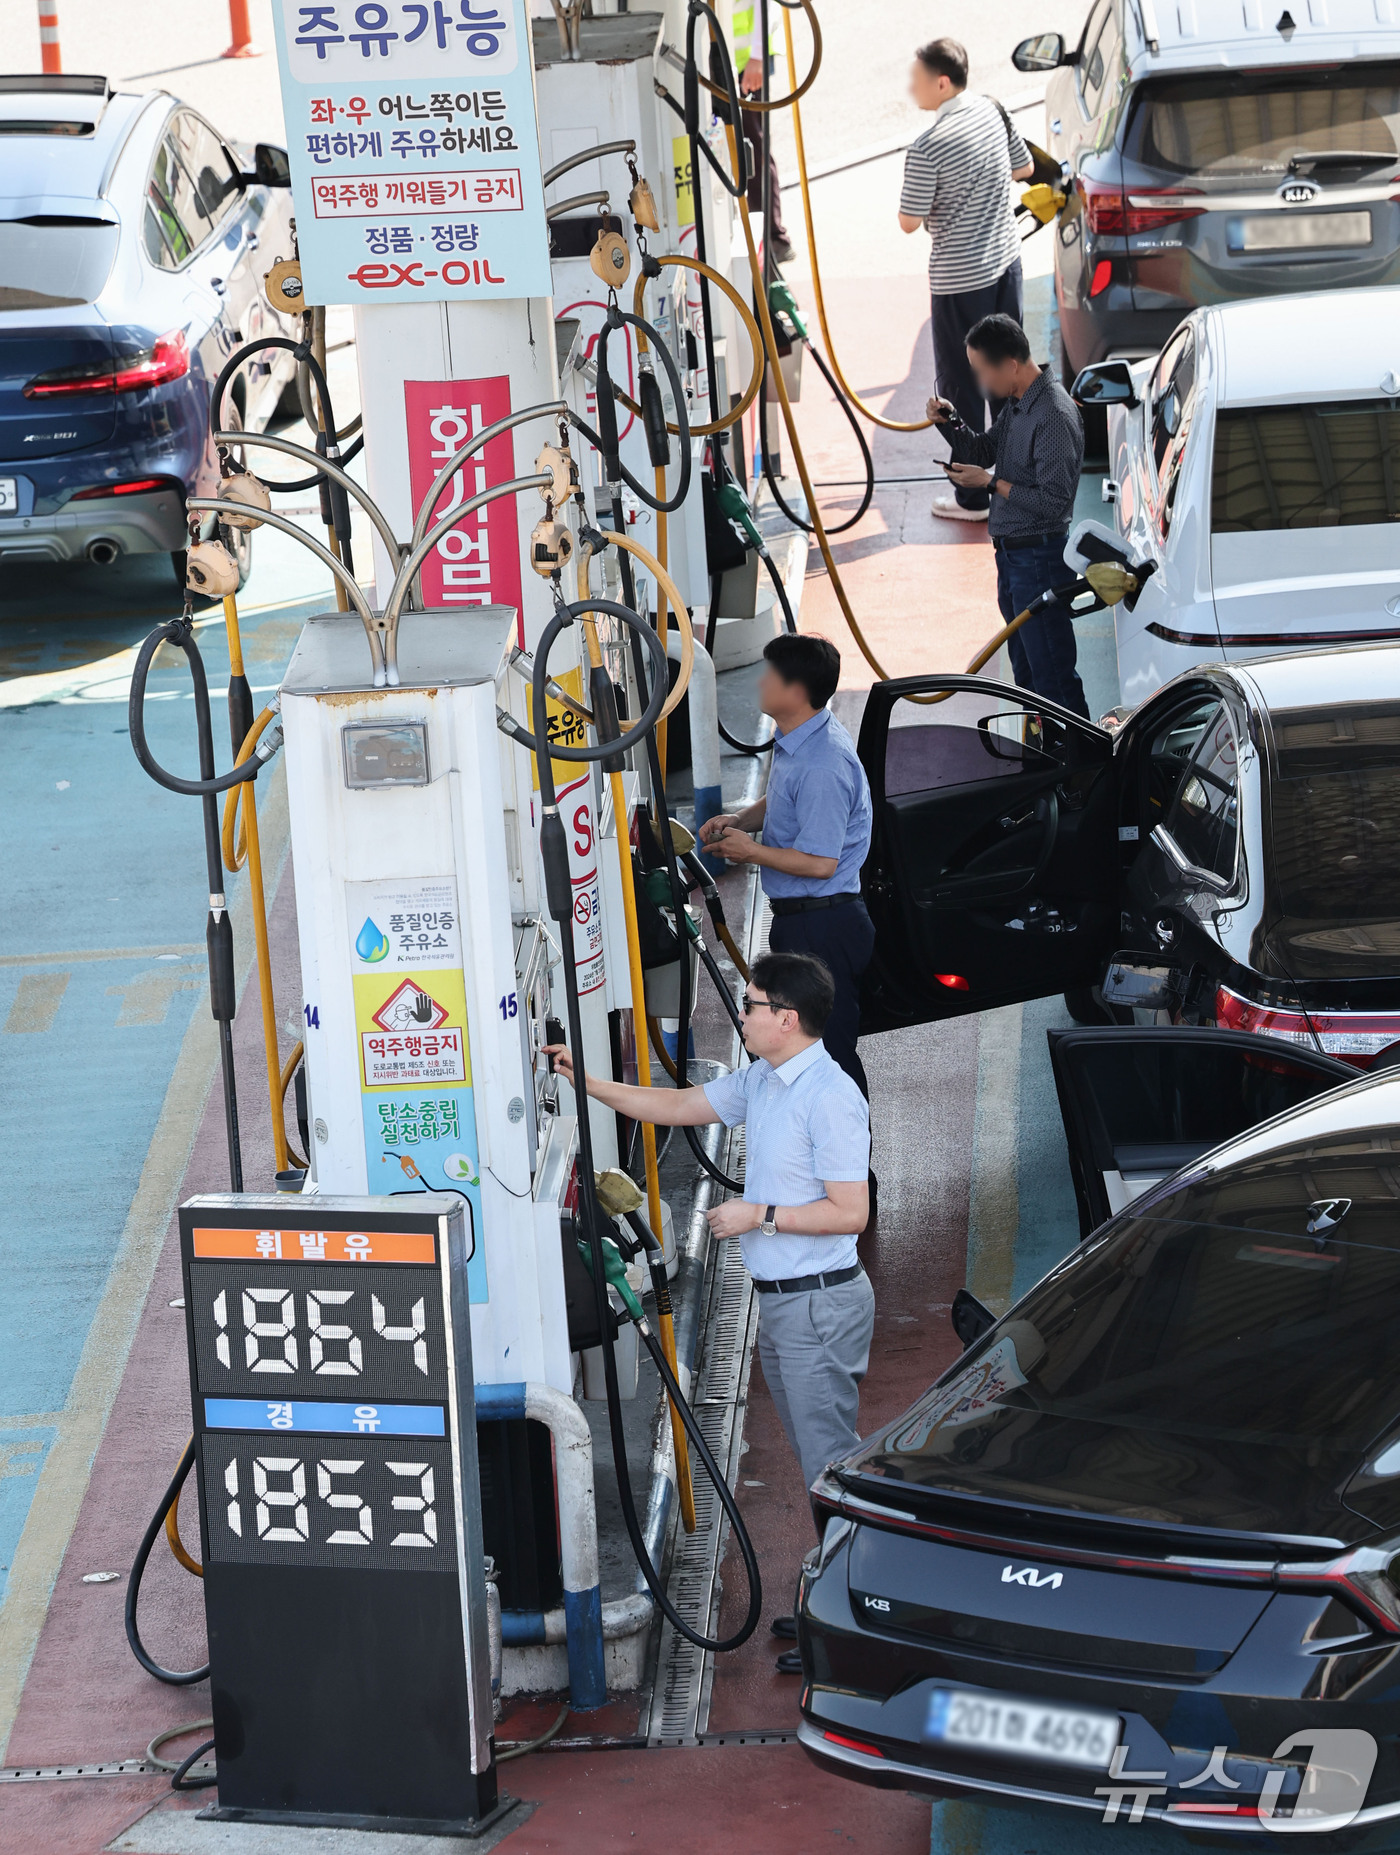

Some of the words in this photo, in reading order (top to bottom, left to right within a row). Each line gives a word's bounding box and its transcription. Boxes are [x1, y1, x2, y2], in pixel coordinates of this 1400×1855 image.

[295, 0, 507, 60] 주유가능
[310, 96, 372, 126] 좌·우
[378, 91, 507, 123] 어느쪽이든
[306, 131, 383, 164] 편하게
[390, 126, 519, 159] 주유하세요
[317, 182, 379, 209] 역주행
[385, 179, 468, 206] 끼워들기
[474, 177, 516, 204] 금지
[1286, 187, 1314, 202] KIA
[365, 226, 414, 255] 정품
[431, 224, 480, 252] 정량
[658, 297, 666, 316] 7
[429, 403, 492, 606] 화기엄
[573, 804, 597, 857] S
[389, 911, 455, 933] 품질인증
[399, 933, 449, 952] 주유소
[304, 1003, 320, 1029] 14
[499, 992, 518, 1021] 15
[368, 1034, 458, 1058] 역주행금지
[373, 1061, 406, 1071] 도로교통법
[407, 1060, 425, 1069] 제5조
[427, 1059, 441, 1068] 신호
[442, 1059, 456, 1067] 또는
[373, 1070, 399, 1079] 지시위반
[401, 1069, 421, 1078] 과태료
[423, 1068, 458, 1077] 대상입니다.
[377, 1099, 458, 1124] 탄소중립
[380, 1121, 460, 1145] 실천하기
[213, 1288, 429, 1376] 1864
[224, 1457, 438, 1547] 1853
[1000, 1564, 1064, 1590] KIA
[864, 1596, 891, 1613] K8
